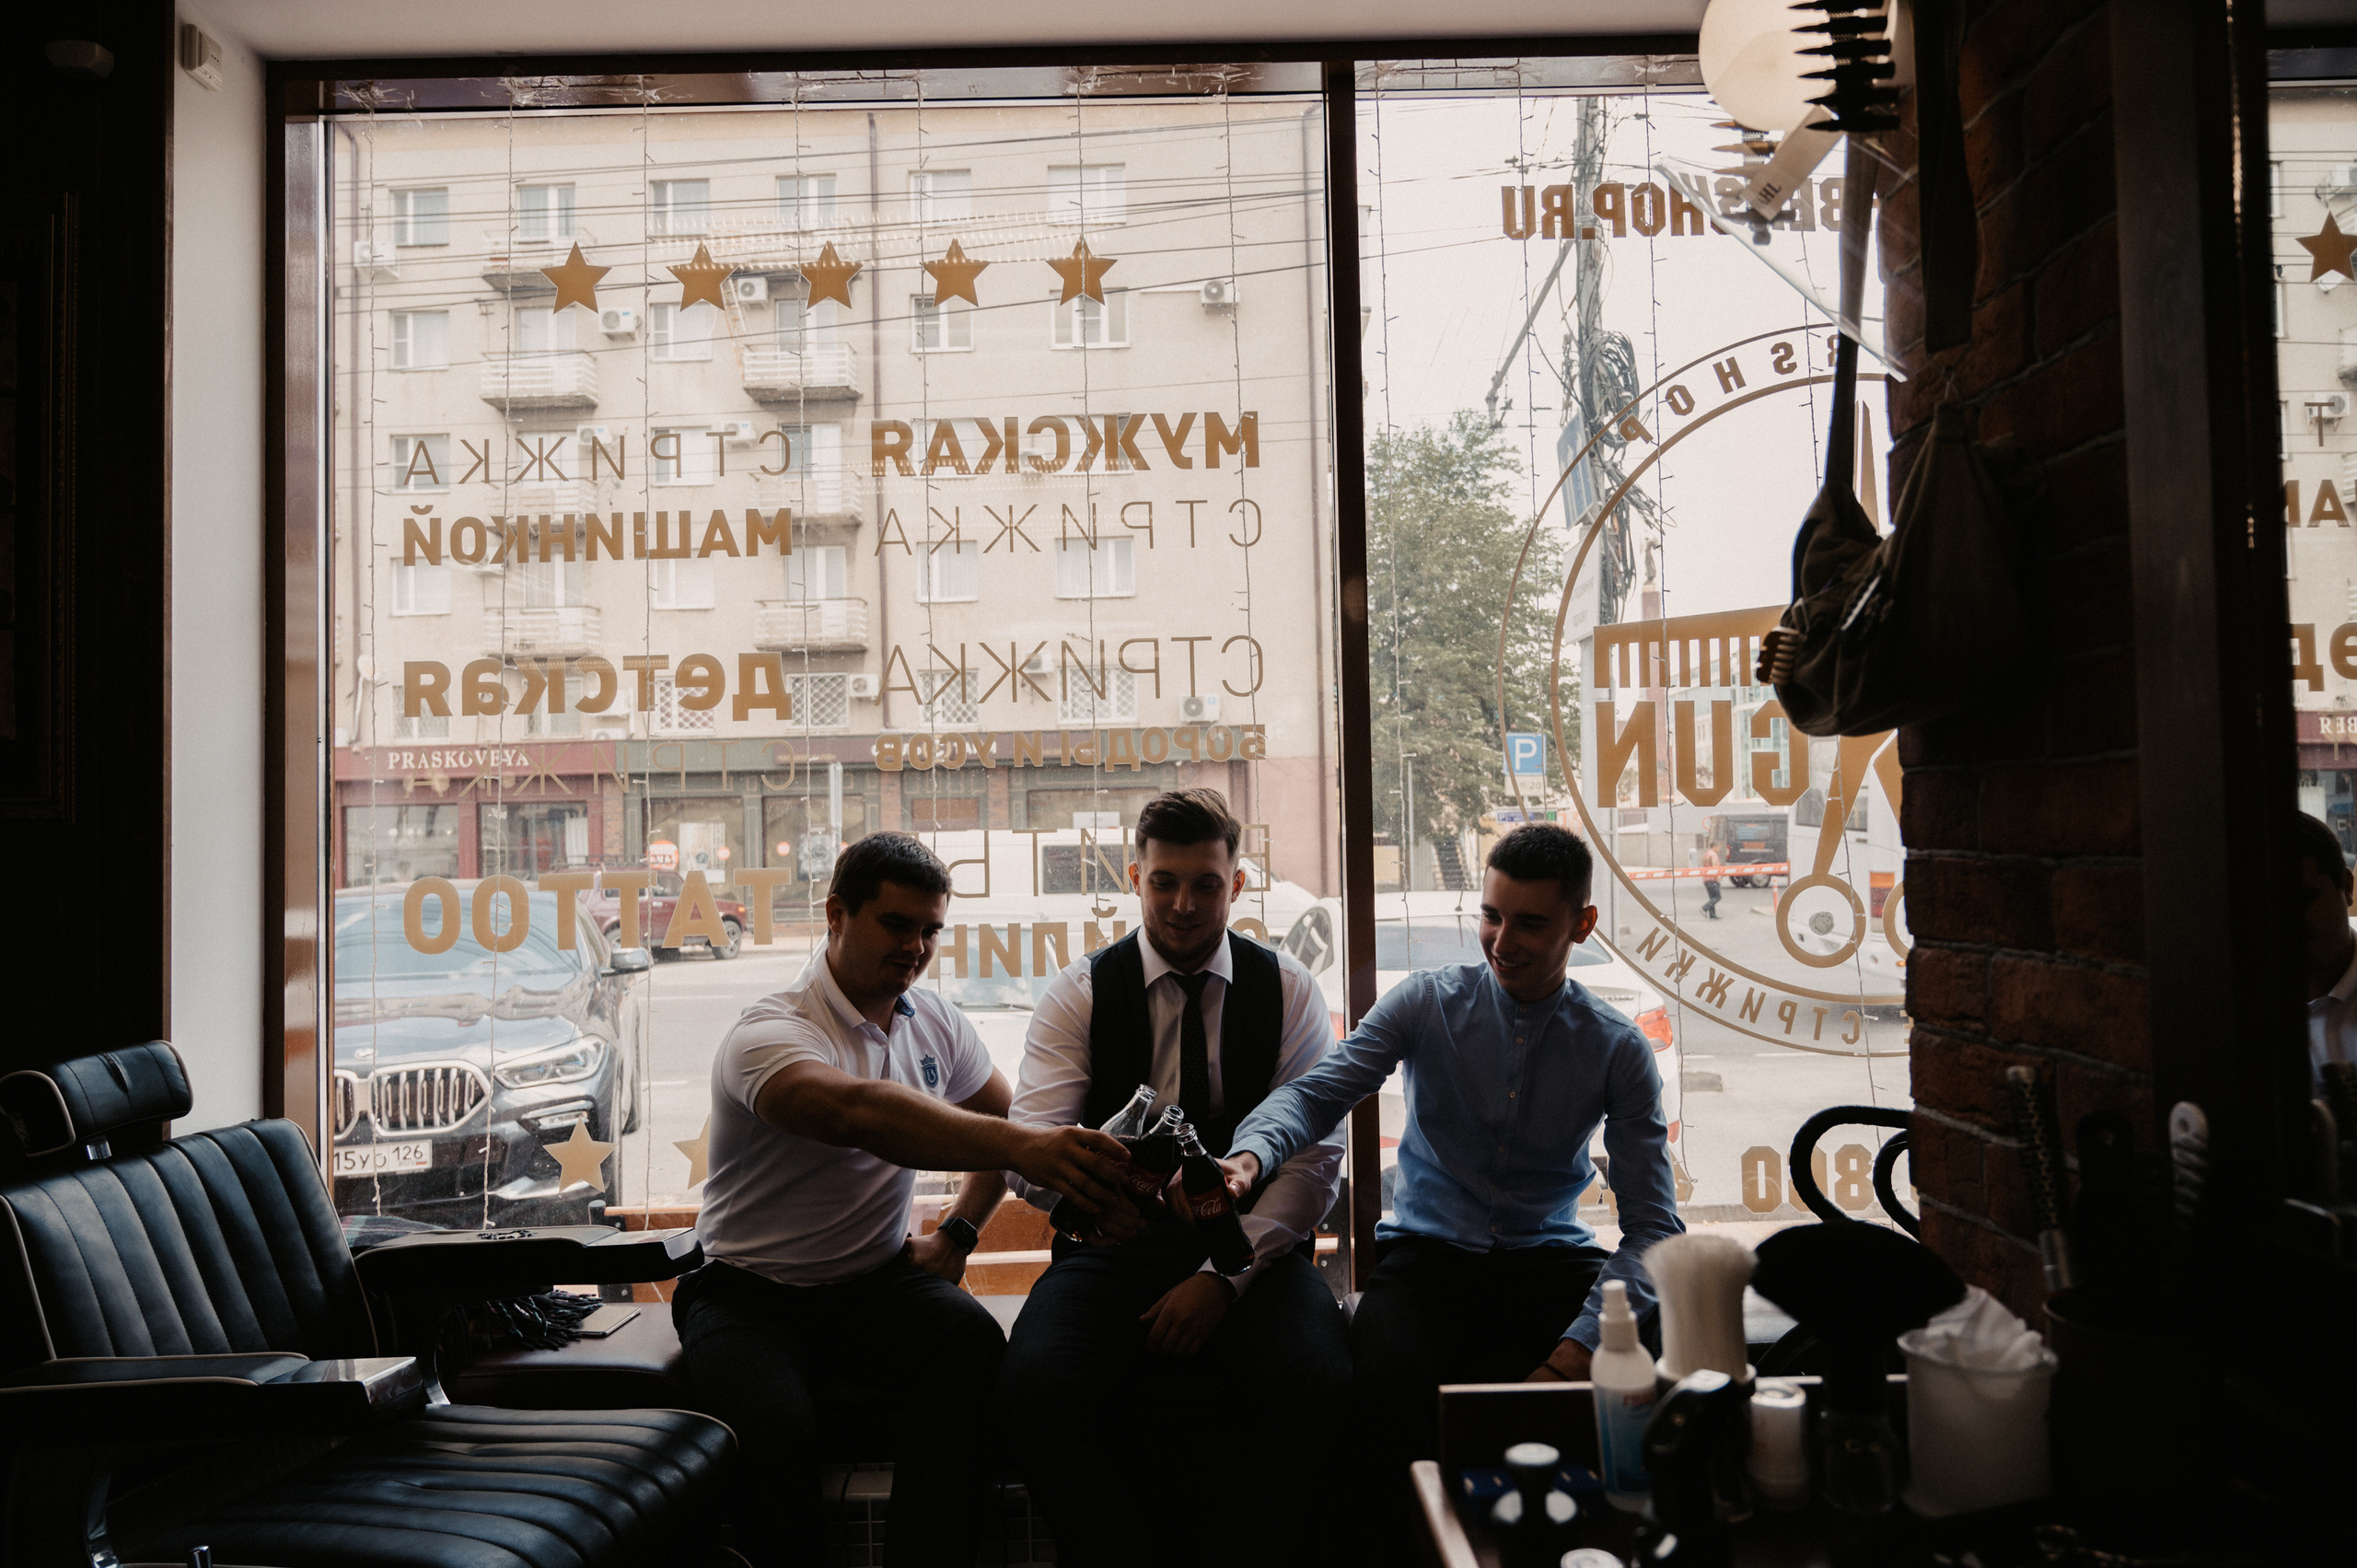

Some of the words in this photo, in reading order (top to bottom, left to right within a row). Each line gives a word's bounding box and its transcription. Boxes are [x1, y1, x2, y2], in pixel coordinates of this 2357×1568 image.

[387, 748, 530, 771] PRASKOVEYA
[1515, 738, 1538, 771] P
[392, 1144, 424, 1161] 126
